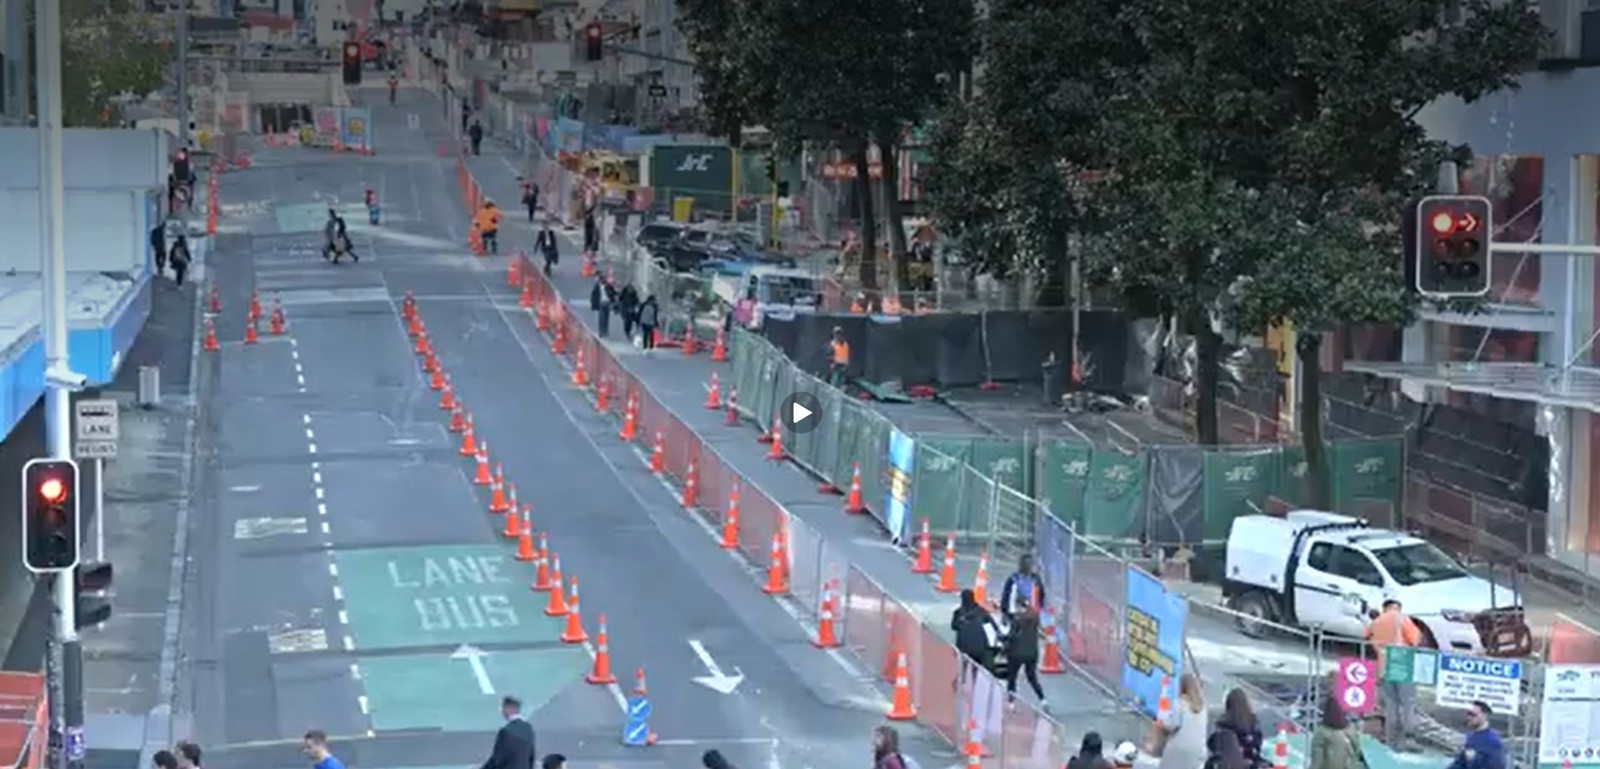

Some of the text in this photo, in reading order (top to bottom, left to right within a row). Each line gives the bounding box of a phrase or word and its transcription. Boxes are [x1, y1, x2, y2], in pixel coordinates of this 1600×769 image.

[82, 424, 111, 435] LANE
[387, 556, 512, 588] LANE
[414, 595, 519, 631] BUS
[1449, 658, 1515, 678] NOTICE
